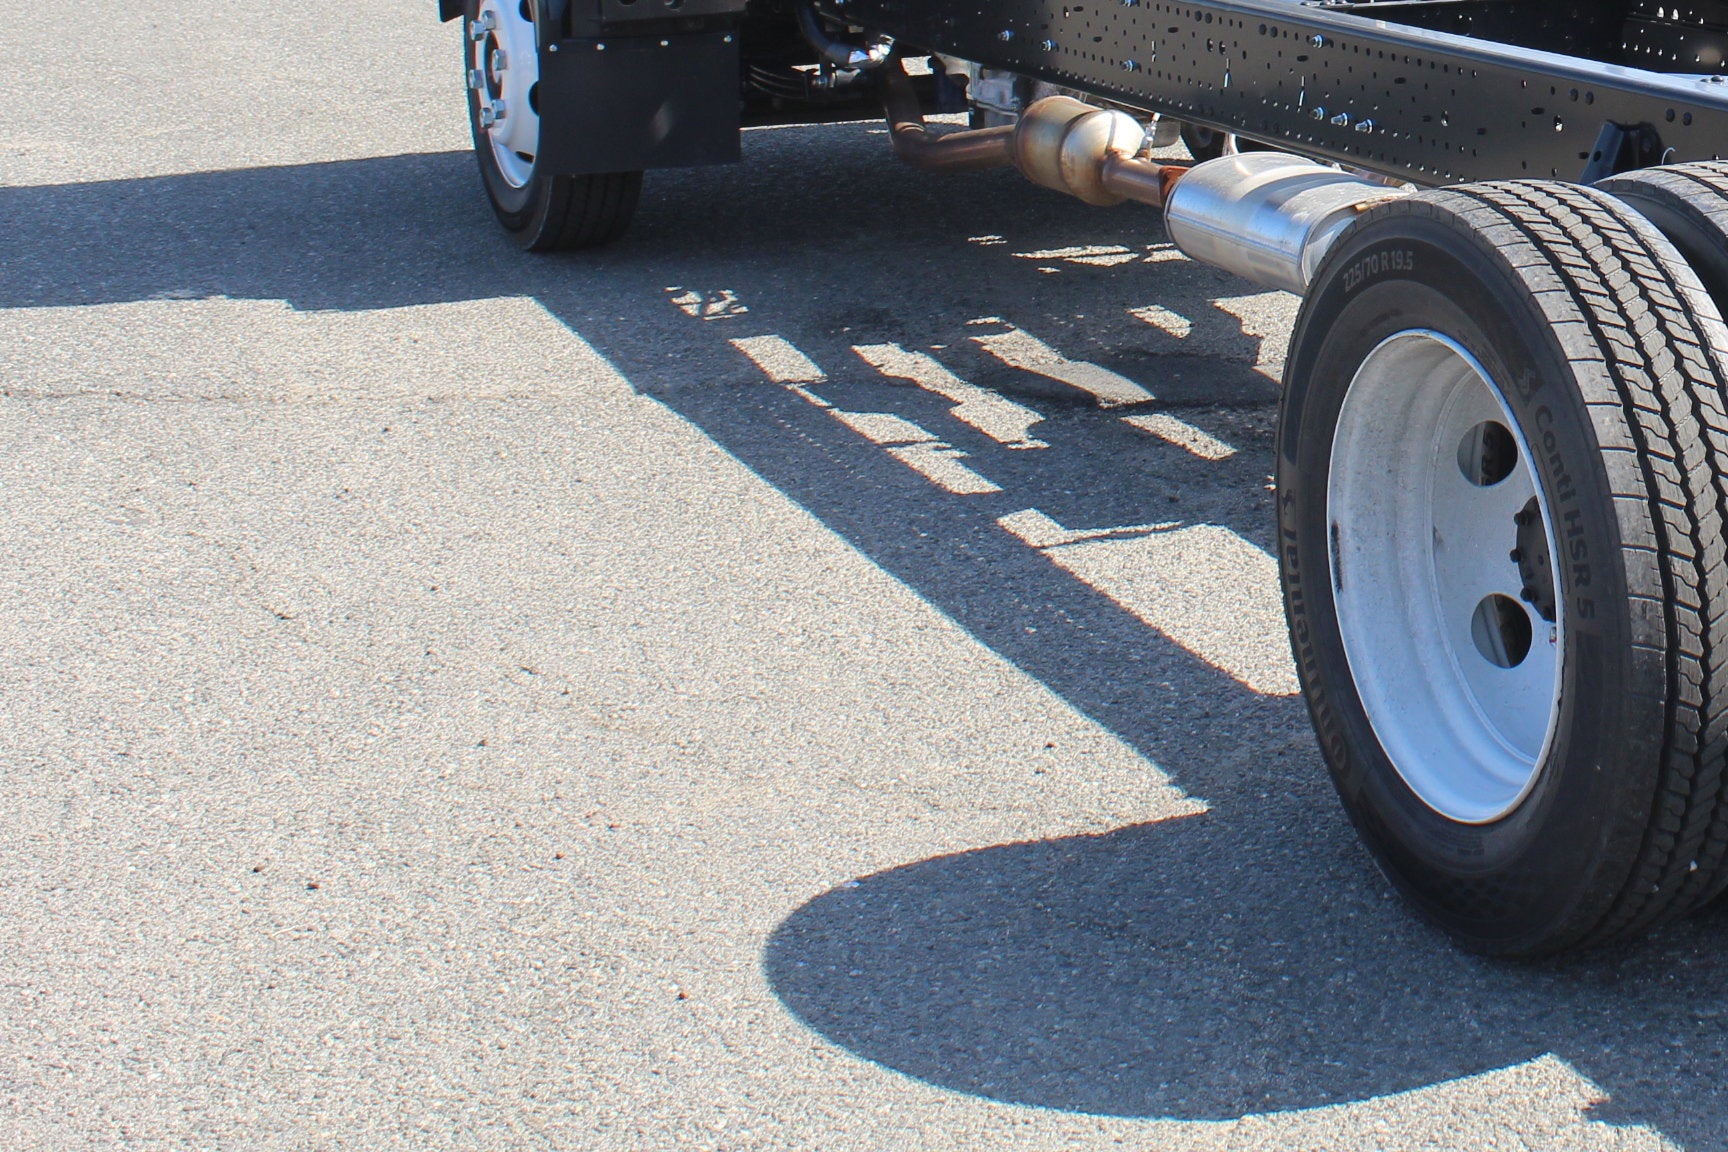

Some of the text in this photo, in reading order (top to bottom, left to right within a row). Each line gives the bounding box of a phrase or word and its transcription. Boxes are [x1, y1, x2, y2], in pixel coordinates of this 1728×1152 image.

[1343, 249, 1415, 294] 225/70 R 19.5
[1535, 404, 1596, 620] Conti HSR 5
